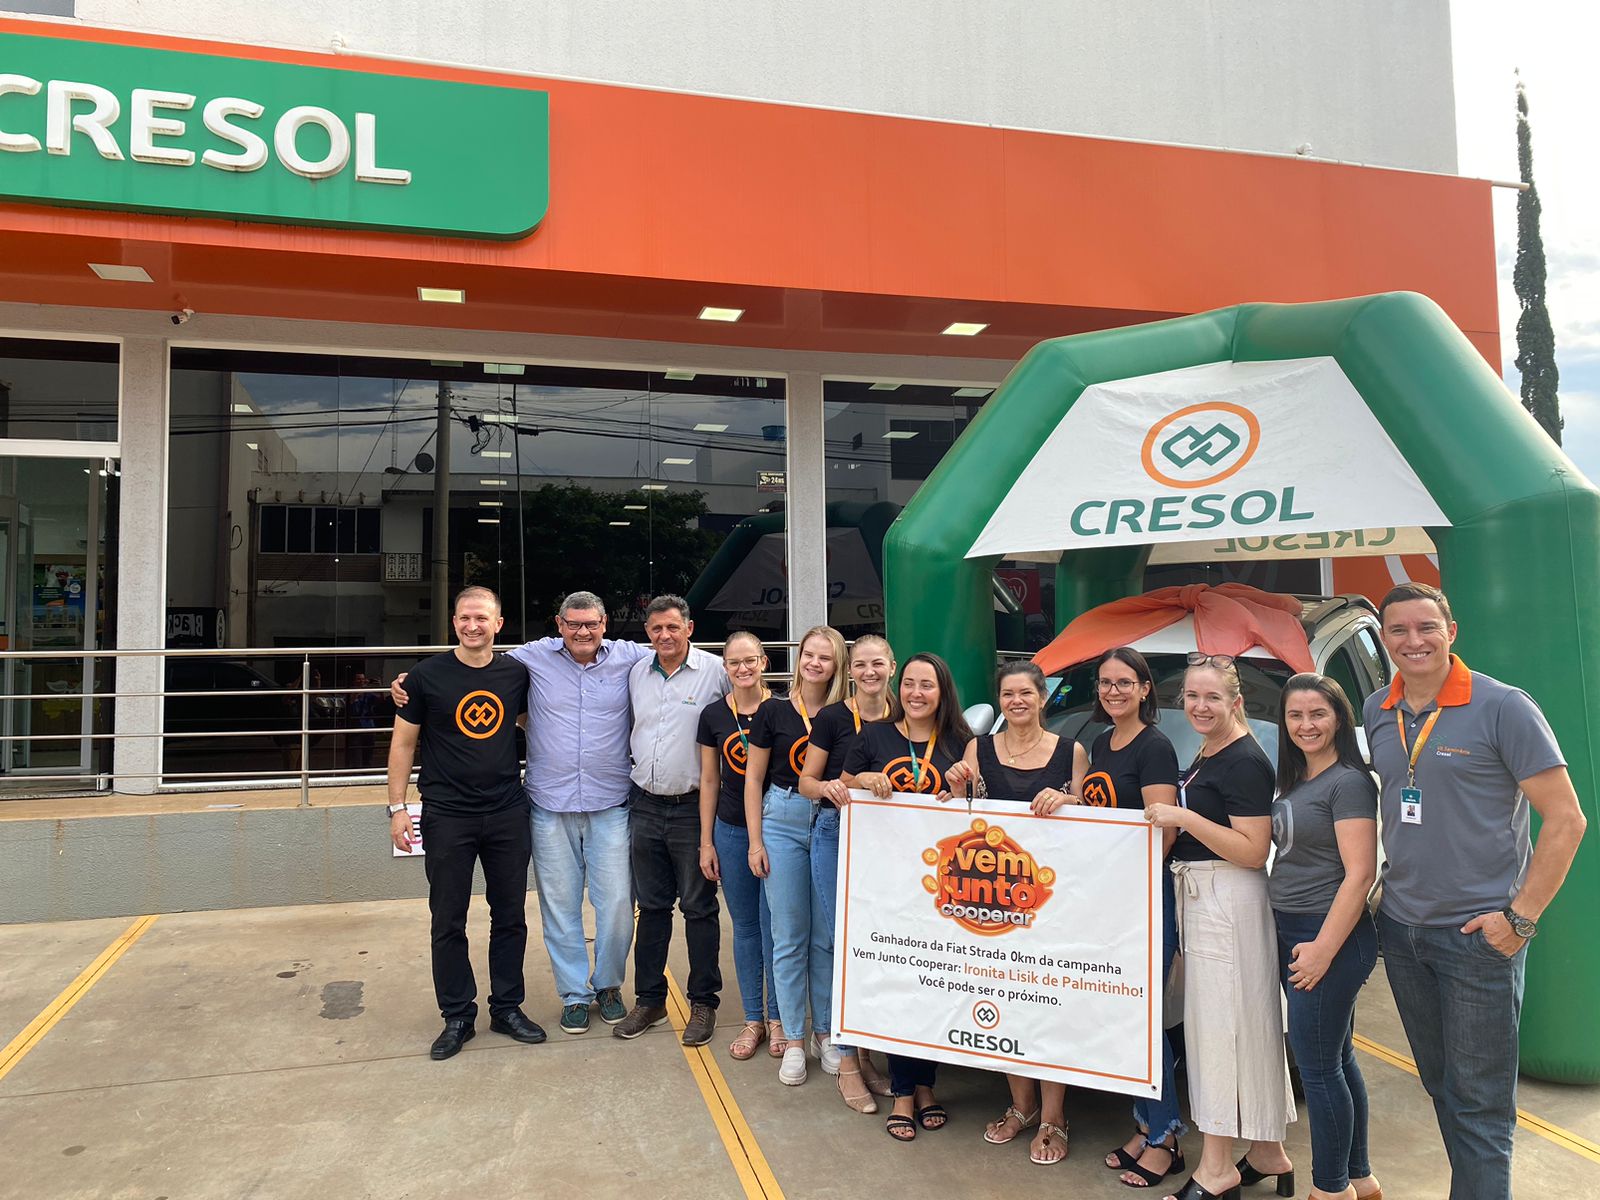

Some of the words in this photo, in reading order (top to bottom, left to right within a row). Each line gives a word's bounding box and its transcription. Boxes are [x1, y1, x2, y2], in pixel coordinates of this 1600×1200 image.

[0, 73, 411, 184] CRESOL
[1070, 486, 1314, 536] CRESOL
[955, 847, 1031, 876] vem
[936, 864, 1037, 908] junto
[941, 903, 1033, 926] cooperar
[853, 947, 876, 960] Vem
[877, 951, 907, 965] Junto
[909, 956, 961, 973] Cooperar:
[964, 963, 1005, 979] Ironita
[1009, 969, 1039, 984] Lisik
[1042, 973, 1058, 987] de
[1062, 976, 1143, 998] Palmitinho!
[871, 932, 928, 950] Ganhadora
[930, 940, 944, 951] da
[946, 942, 967, 955] Fiat
[969, 946, 1006, 960] Strada
[1010, 951, 1036, 964] 0km
[1039, 955, 1054, 967] da
[1057, 959, 1122, 975] campanha
[918, 974, 945, 989] Você
[947, 981, 975, 993] pode
[977, 985, 995, 996] ser
[997, 988, 1005, 998] o
[1008, 990, 1062, 1006] próximo.
[948, 1028, 1025, 1056] CRESOL
